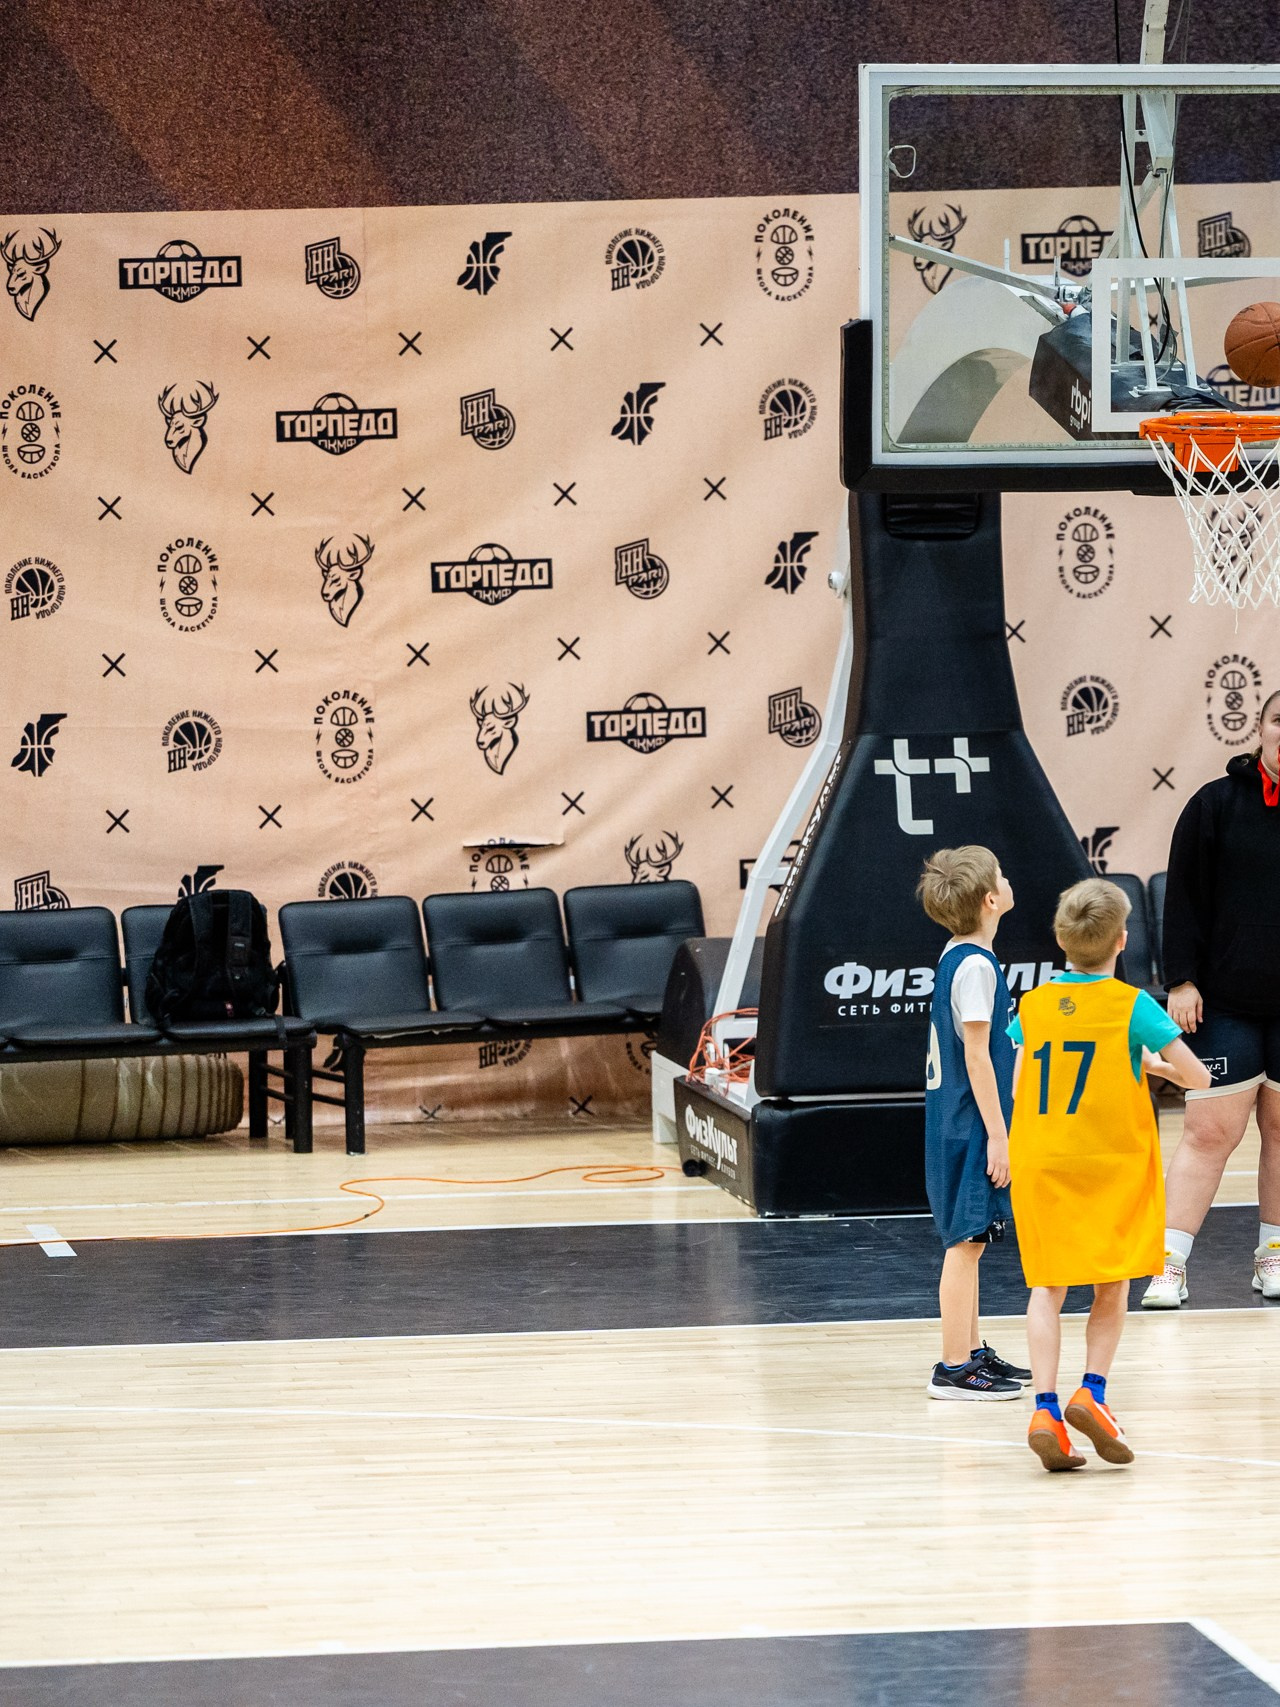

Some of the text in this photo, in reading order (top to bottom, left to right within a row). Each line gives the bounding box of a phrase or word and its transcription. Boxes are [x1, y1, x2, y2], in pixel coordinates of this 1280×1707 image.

[754, 209, 814, 243] ПОКОЛЕНИЕ
[605, 229, 633, 264] ПОКОЛЕНИЕ
[635, 228, 665, 255] НИЖНЕГО
[1025, 236, 1108, 260] ТОРПЕ
[123, 260, 238, 286] ТОРПЕДО
[0, 385, 61, 420] ПОКОЛЕНИЕ
[759, 379, 787, 414] ПОКОЛЕНИЕ
[789, 378, 819, 405] НИЖНЕГО
[280, 412, 394, 438] ТОРПЕДО
[2, 443, 60, 479] ШКОЛА БАСКЕТБОЛА
[1056, 507, 1115, 541] ПОКОЛЕНИЕ
[157, 538, 219, 573] ПОКОЛЕНИЕ
[5, 557, 65, 620] ПОКОЛЕНИЕ НИЖНЕГО НОВГОРОДА
[434, 563, 549, 589] ТОРПЕДО
[159, 596, 218, 632] ШКОЛА БАСКЕТБОЛА
[1205, 655, 1262, 688] ПОКОЛЕНИЕ
[314, 691, 374, 725] ПОКОЛЕНИЕ
[590, 712, 703, 737] ТОРПЕДО
[162, 711, 190, 746] ПОКОЛЕНИЕ
[192, 710, 222, 737] НИЖНЕГО
[316, 748, 373, 784] ШКОЛА БАСКЕТБОЛА
[318, 862, 345, 897] ПОКОЛЕНИЕ
[347, 861, 377, 888] НИЖНЕГО
[838, 1004, 881, 1017] СЕТЬ
[1033, 1041, 1096, 1115] 17
